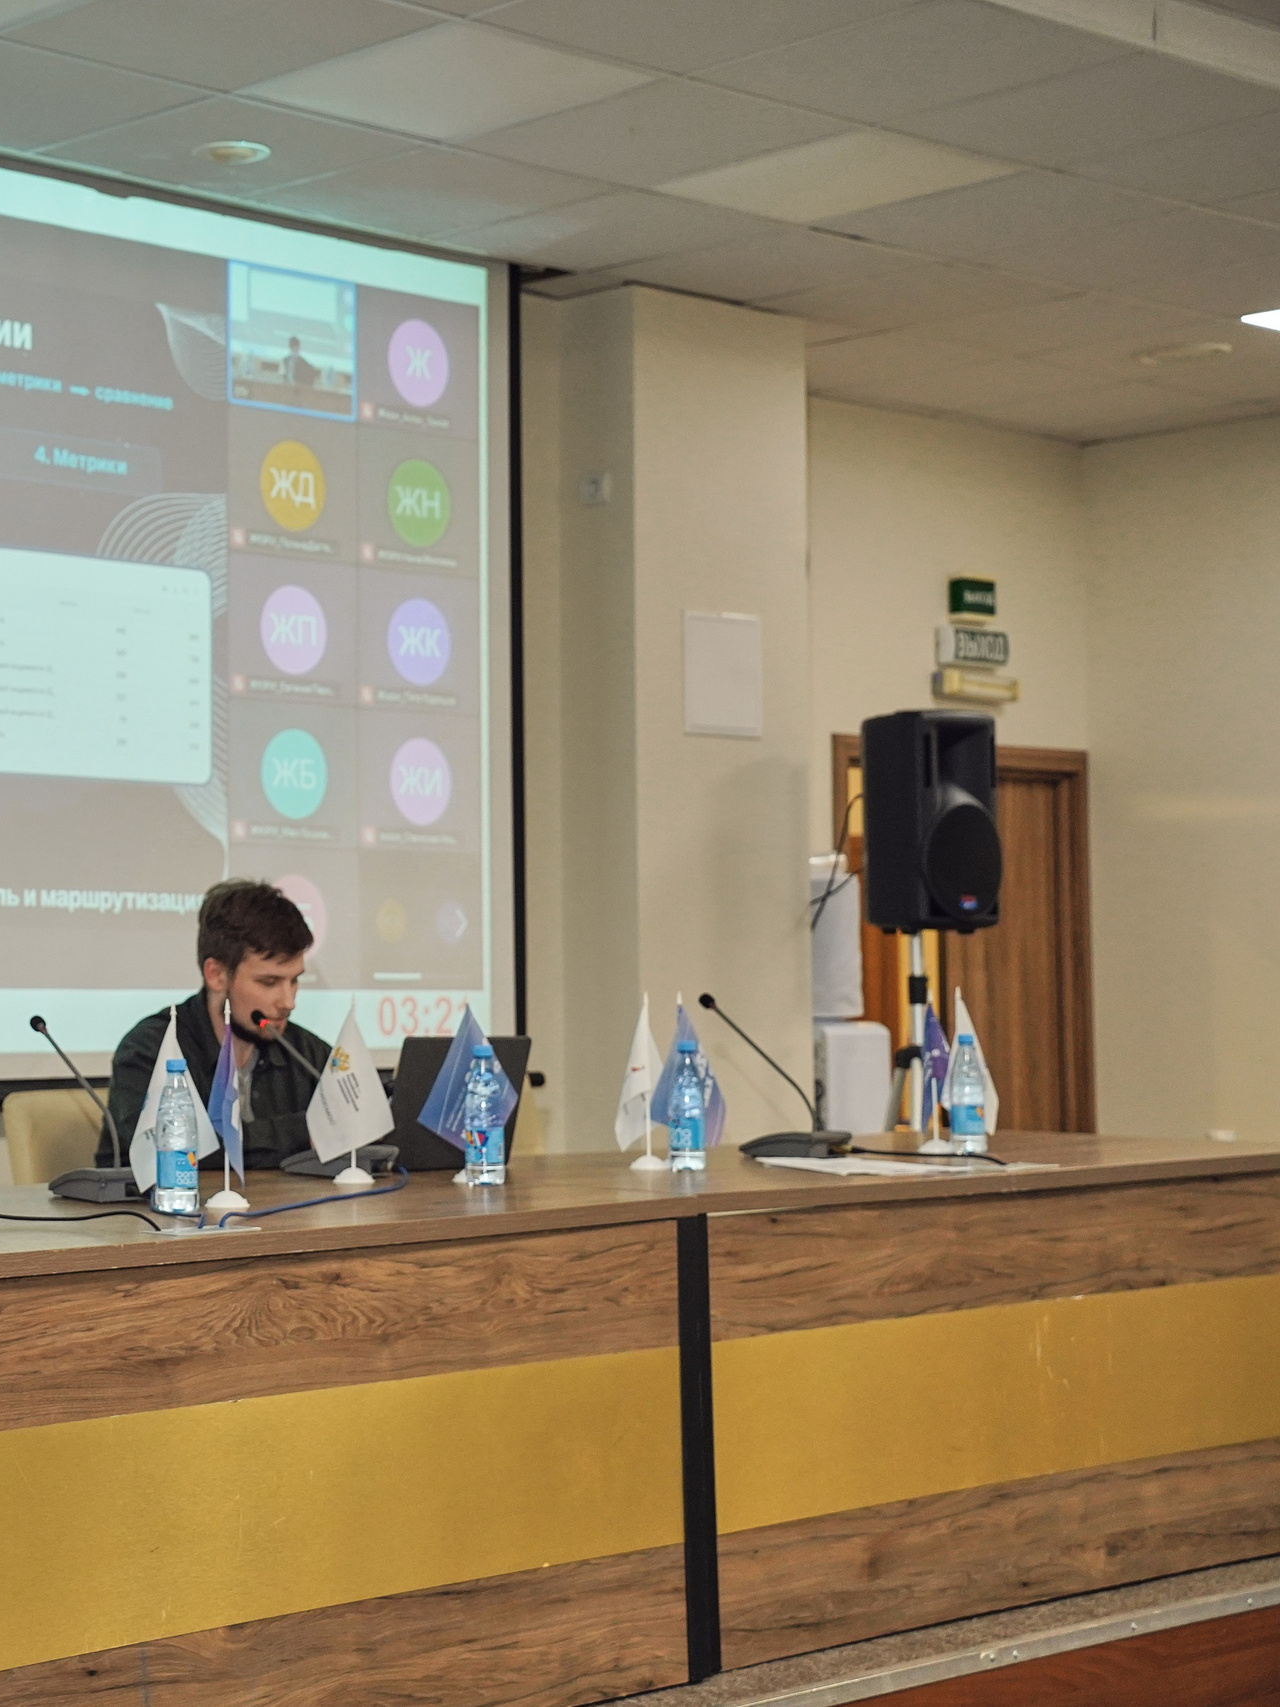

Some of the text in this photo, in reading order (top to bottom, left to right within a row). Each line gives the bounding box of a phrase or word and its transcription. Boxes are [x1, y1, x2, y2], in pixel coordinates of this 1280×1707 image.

[405, 344, 432, 382] Ж
[33, 445, 128, 476] 4. Метрики
[268, 466, 317, 511] ЖД
[394, 485, 441, 521] ЖН
[269, 612, 318, 646] ЖП
[397, 624, 442, 659] ЖК
[272, 756, 317, 790] ЖБ
[397, 764, 443, 798] ЖИ
[23, 888, 38, 908] и
[377, 995, 472, 1036] 03:2
